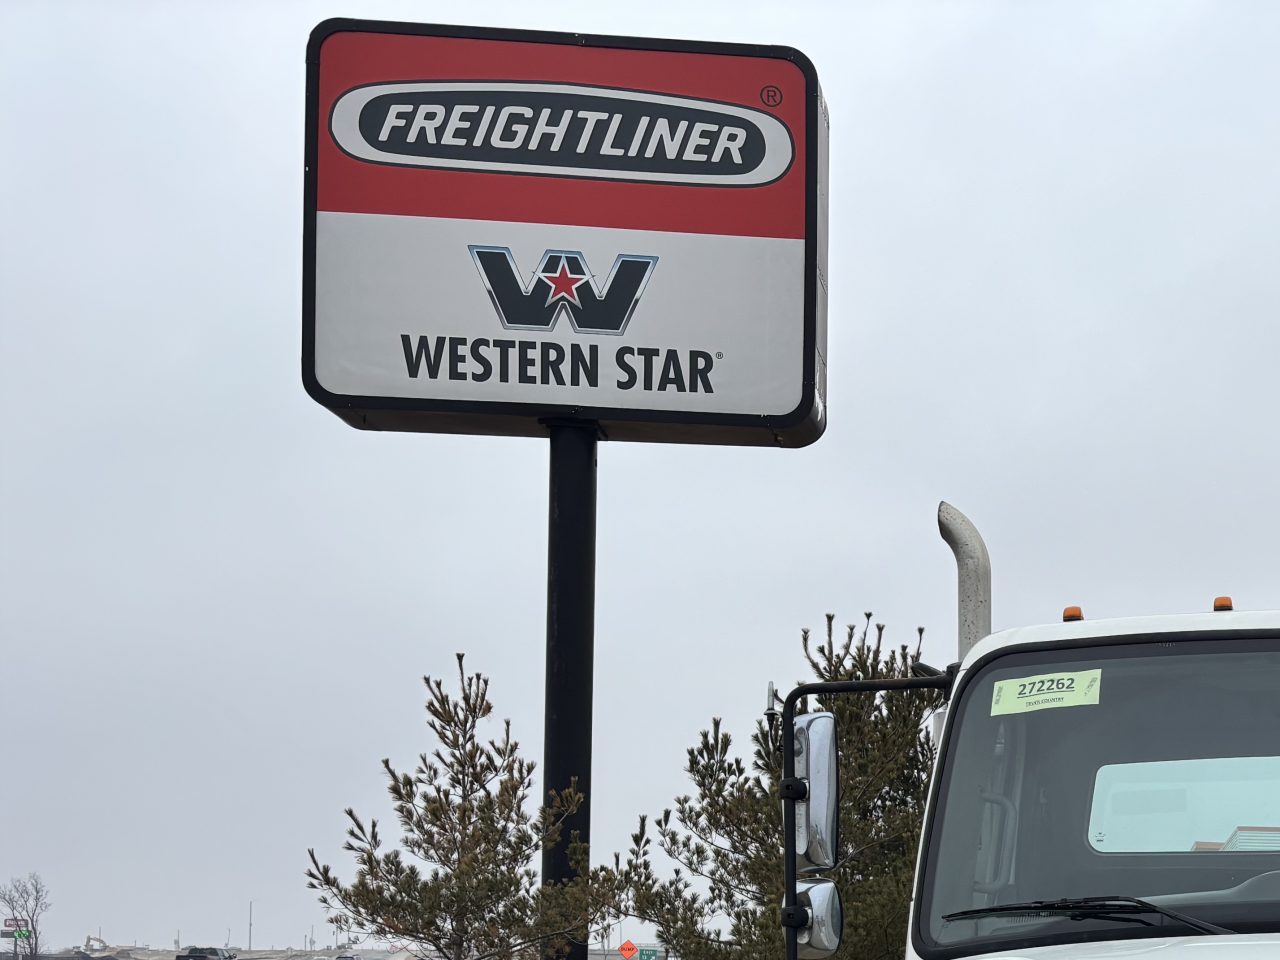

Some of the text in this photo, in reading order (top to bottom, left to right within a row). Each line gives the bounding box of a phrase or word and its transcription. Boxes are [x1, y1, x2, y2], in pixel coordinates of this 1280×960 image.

[378, 103, 749, 165] FREIGHTLINER
[400, 333, 715, 394] WESTERN STAR
[1018, 677, 1075, 696] 272262
